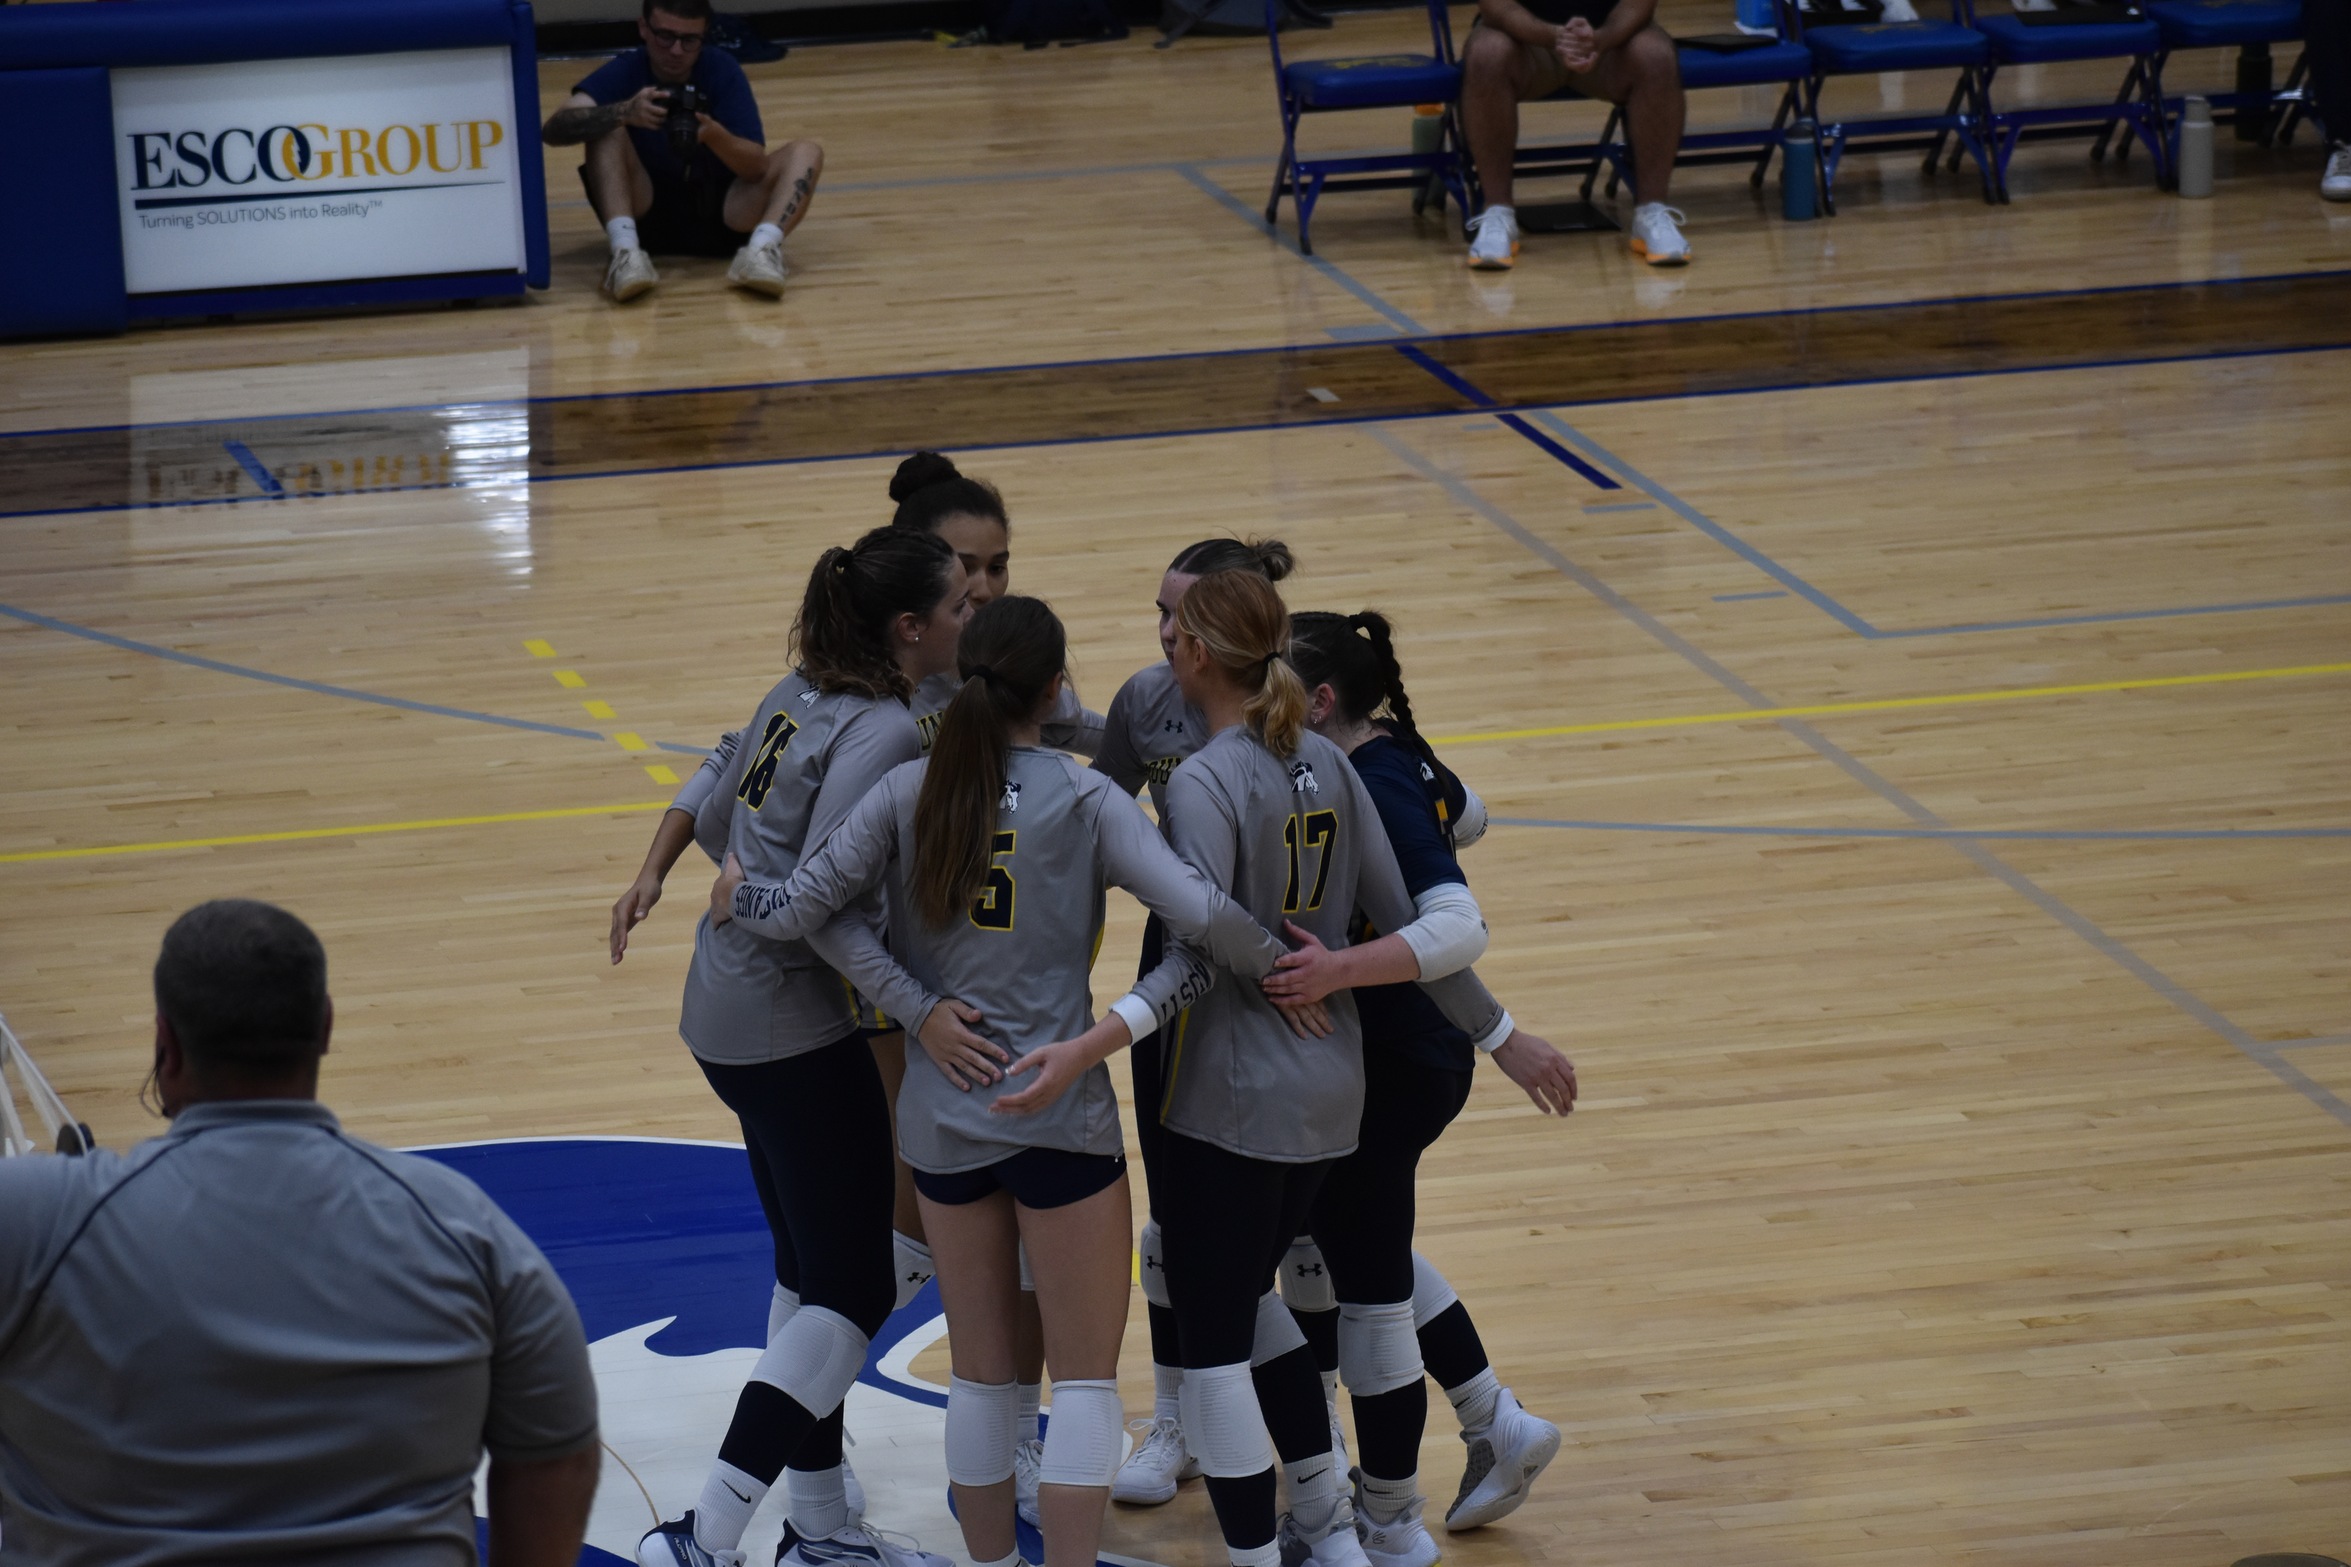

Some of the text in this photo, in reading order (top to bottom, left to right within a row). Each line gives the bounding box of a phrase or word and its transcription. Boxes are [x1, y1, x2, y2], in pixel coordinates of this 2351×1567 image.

[139, 214, 194, 229] Turning
[197, 207, 287, 225] SOLUTIONS
[290, 207, 318, 219] into
[737, 710, 799, 812] 16
[968, 829, 1016, 931] 5
[1282, 808, 1339, 913] 17
